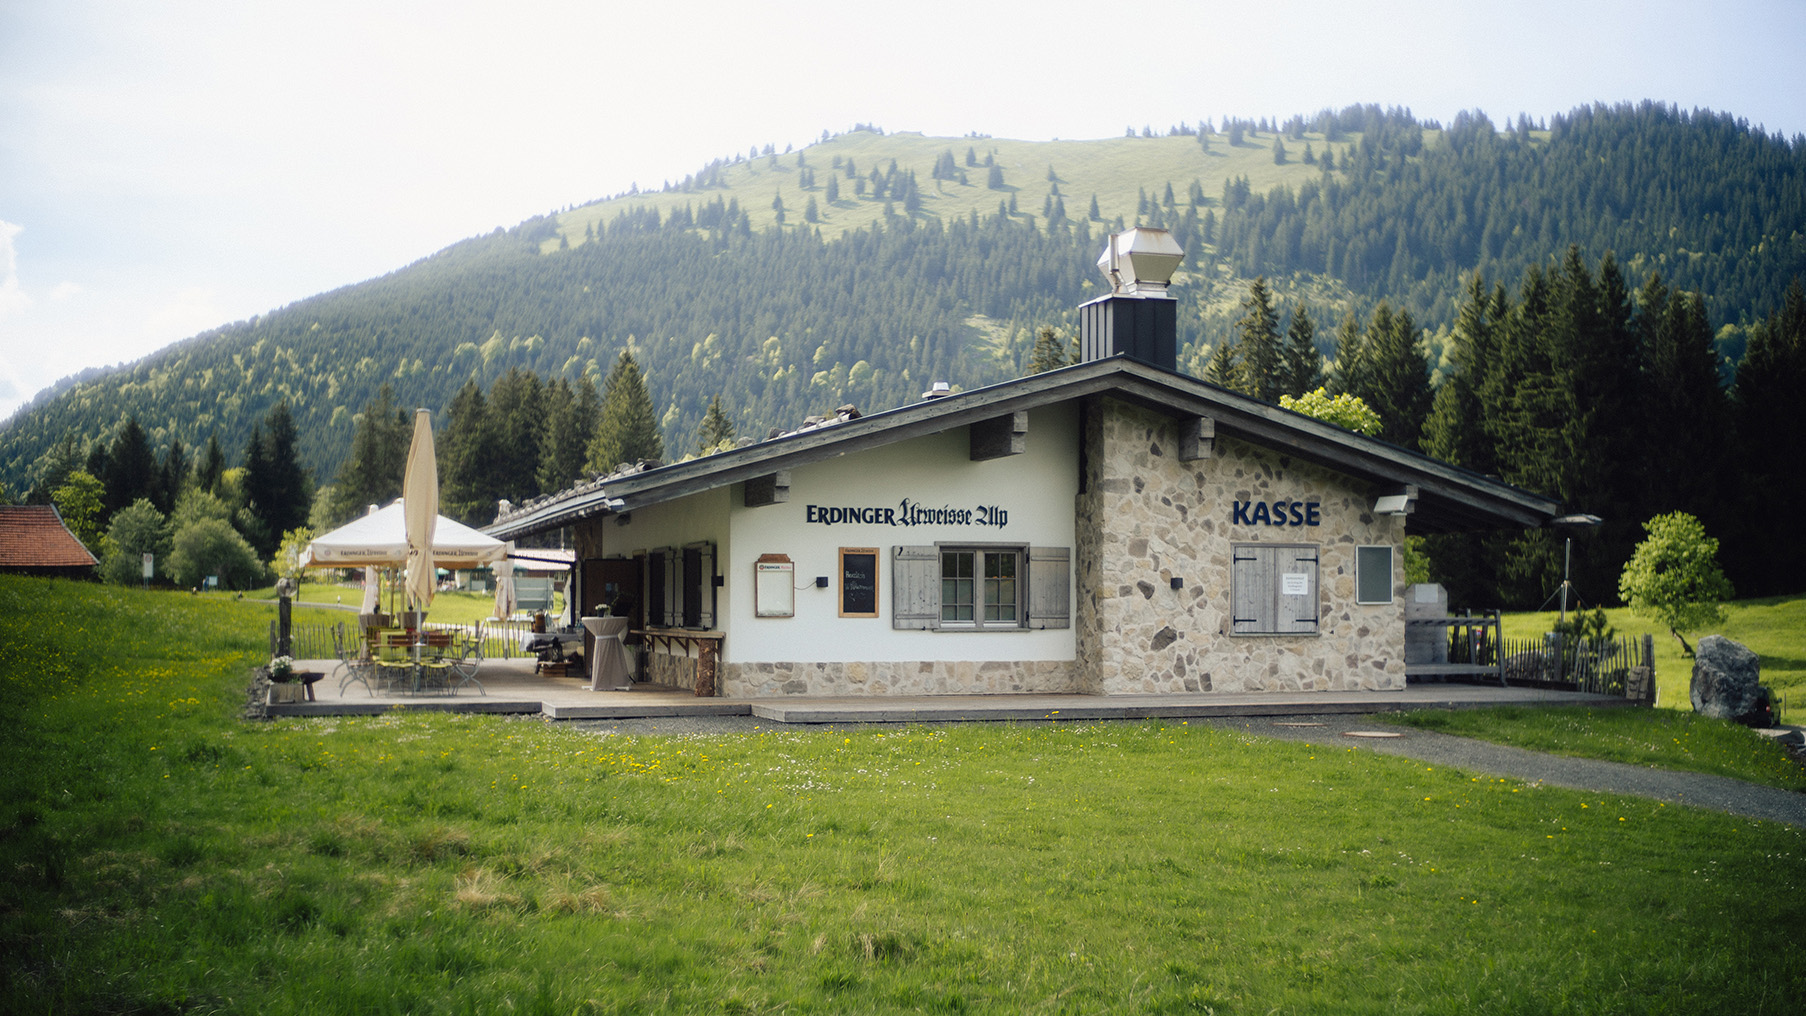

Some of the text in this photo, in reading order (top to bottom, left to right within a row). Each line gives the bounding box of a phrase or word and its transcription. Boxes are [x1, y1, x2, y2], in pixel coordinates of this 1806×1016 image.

[806, 497, 1009, 529] ERDINGER Urweisse Alp
[1233, 500, 1320, 526] KASSE
